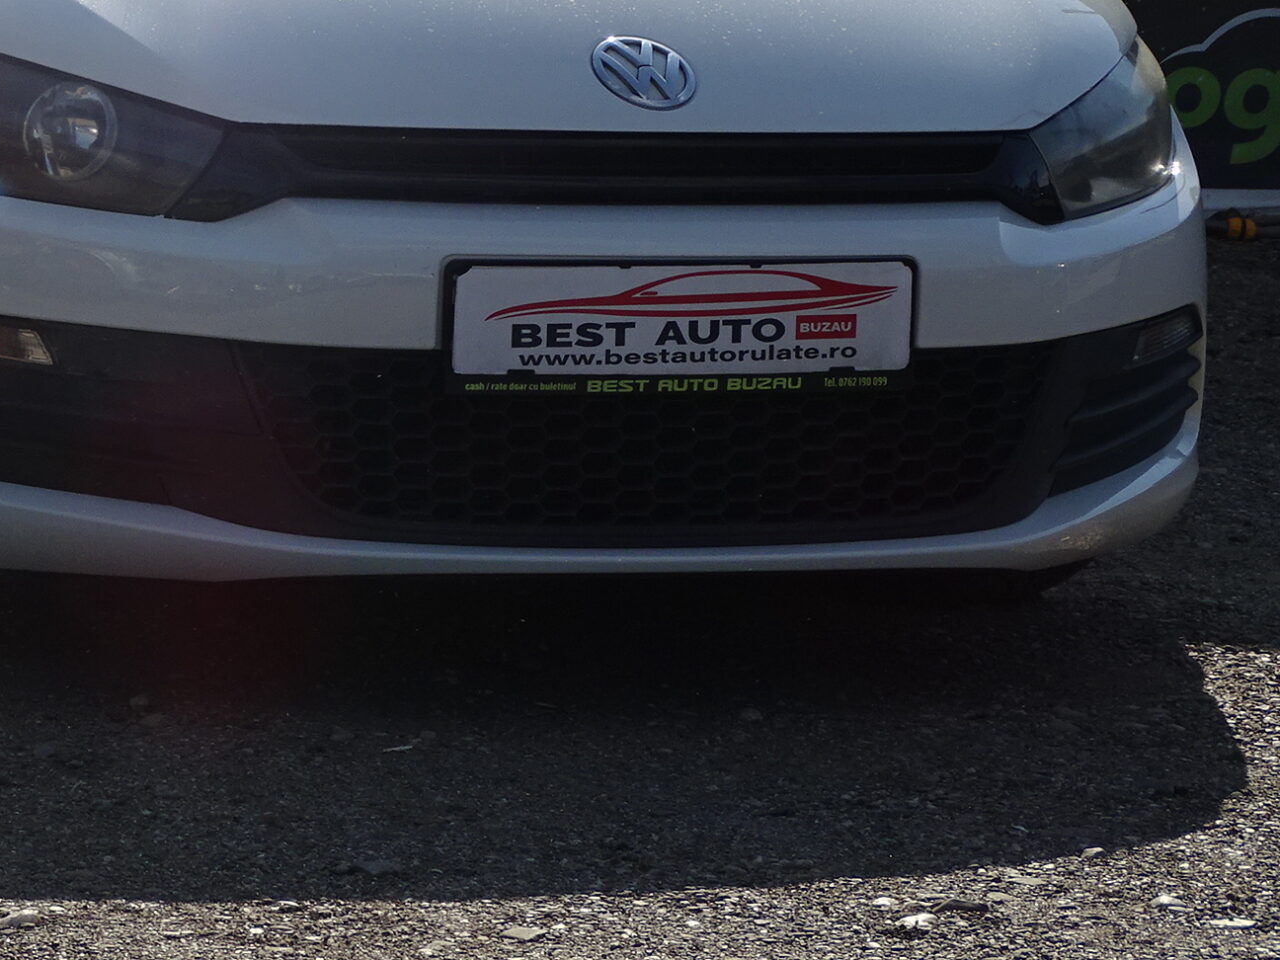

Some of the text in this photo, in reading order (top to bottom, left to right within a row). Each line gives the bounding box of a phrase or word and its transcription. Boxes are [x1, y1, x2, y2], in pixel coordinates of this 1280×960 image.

[510, 317, 852, 349] BEST AUTO BUZAU
[518, 344, 858, 367] www.bestautorulate.ro
[464, 381, 484, 391] cash
[587, 379, 650, 393] BEST
[658, 377, 719, 392] AUTO
[726, 376, 802, 391] BUZAU
